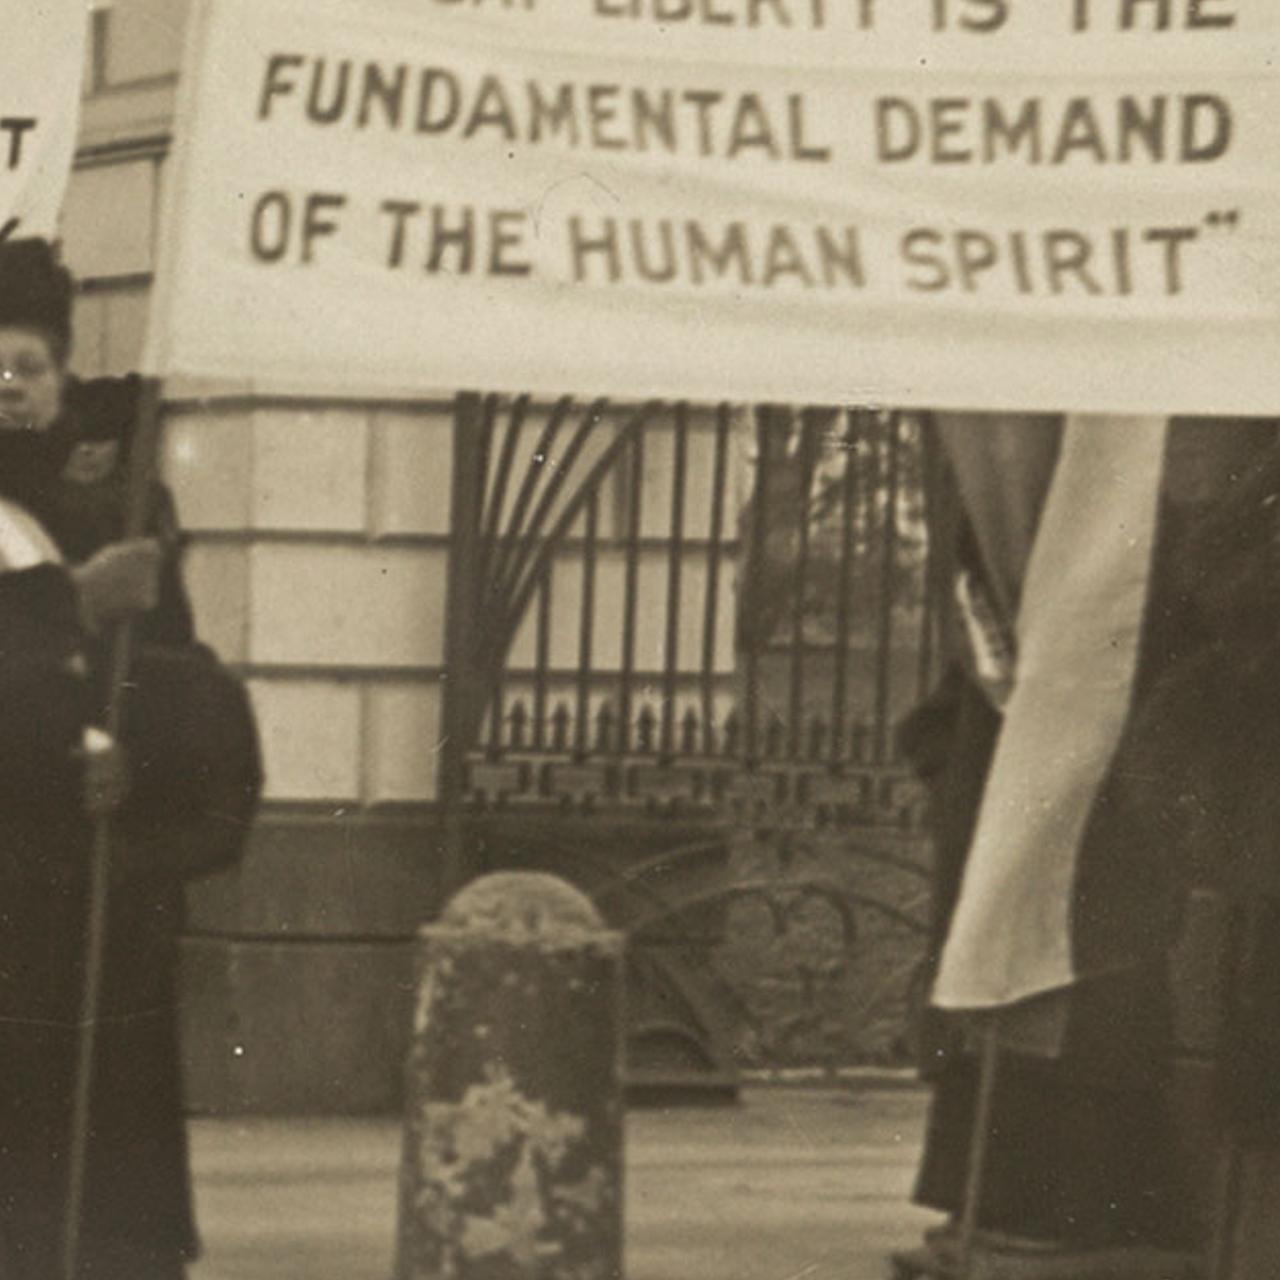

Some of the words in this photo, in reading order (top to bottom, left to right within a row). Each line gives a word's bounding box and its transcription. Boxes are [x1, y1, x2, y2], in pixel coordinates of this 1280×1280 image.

[256, 52, 832, 162] FUNDAMENTAL
[874, 92, 1234, 166] DEMAND
[249, 190, 346, 264] OF
[380, 198, 532, 279] THE
[567, 214, 867, 292] HUMAN
[899, 209, 1240, 297] SPIRIT"
